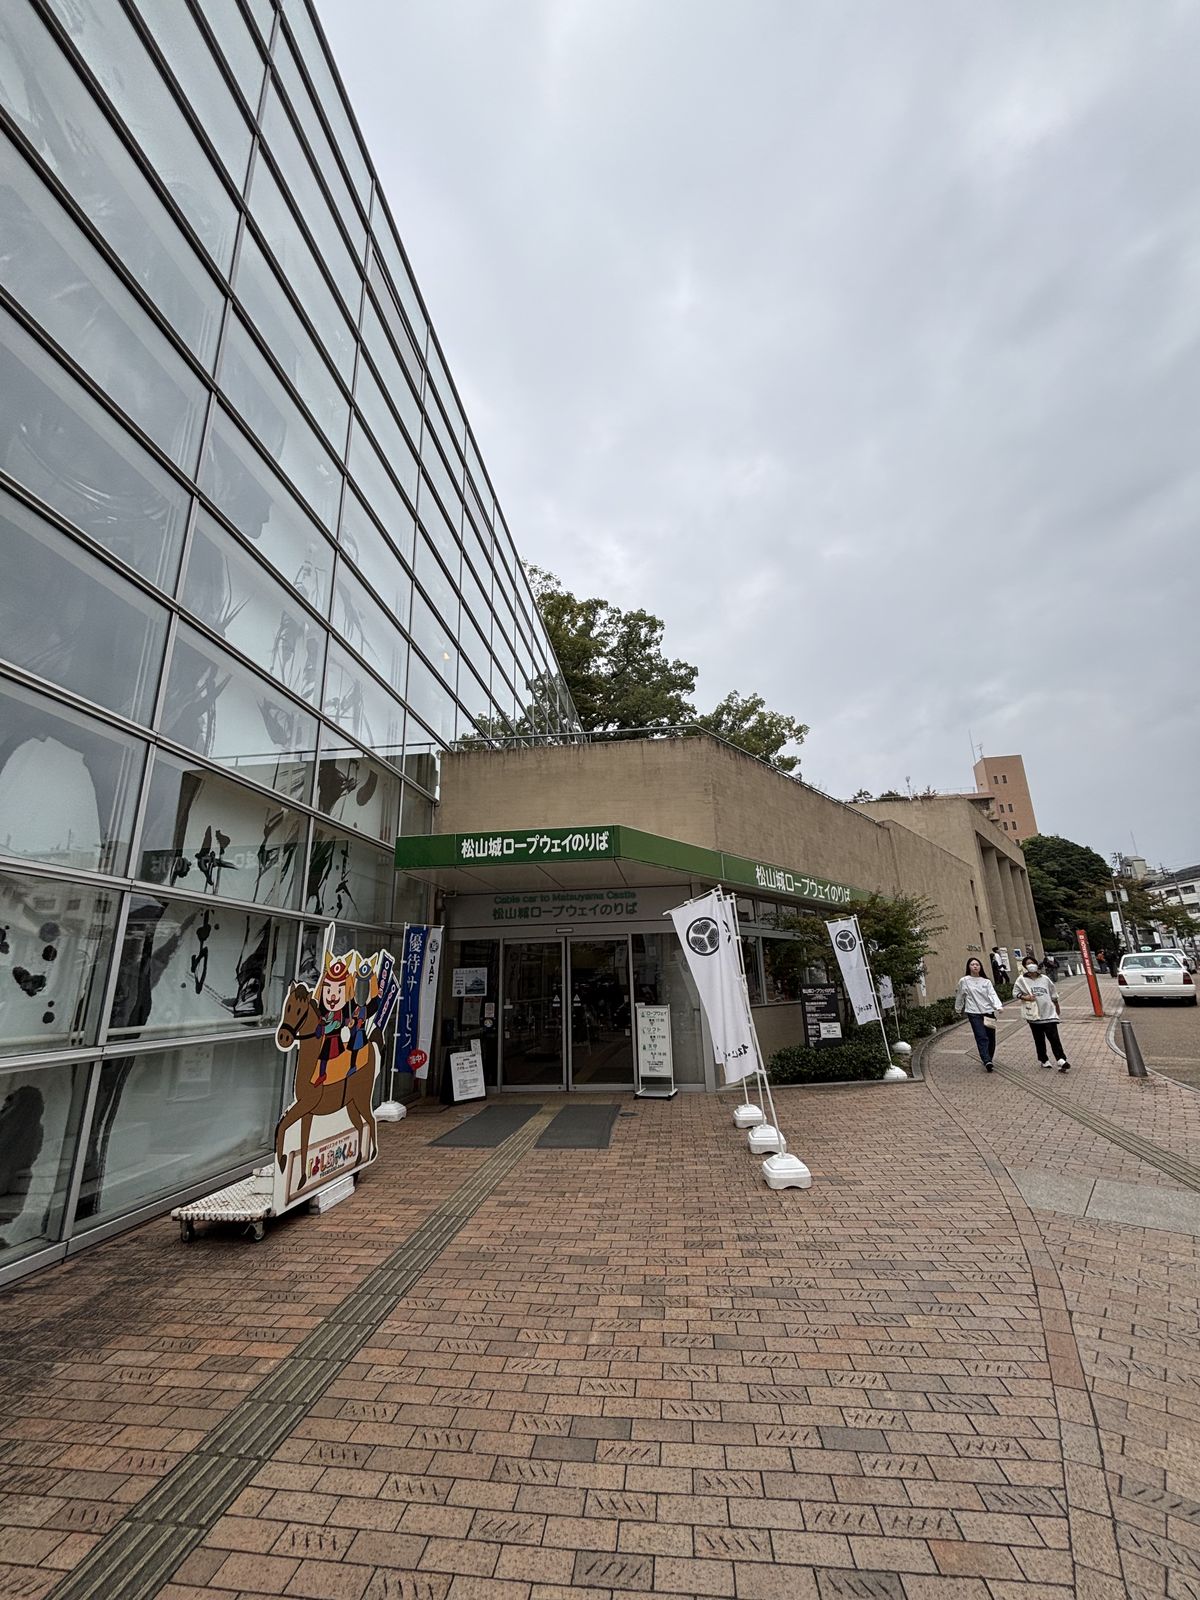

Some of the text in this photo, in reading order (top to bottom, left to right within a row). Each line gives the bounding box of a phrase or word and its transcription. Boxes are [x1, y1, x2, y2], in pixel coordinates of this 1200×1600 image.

[461, 830, 610, 859] 松山城ロープウェイのりば
[494, 890, 637, 904] Cable car to Matsuyama Castle
[755, 864, 851, 903] 松山城ロープウェイのりば
[492, 902, 638, 920] 松山城ロープウェイのりば
[428, 955, 436, 985] JAF
